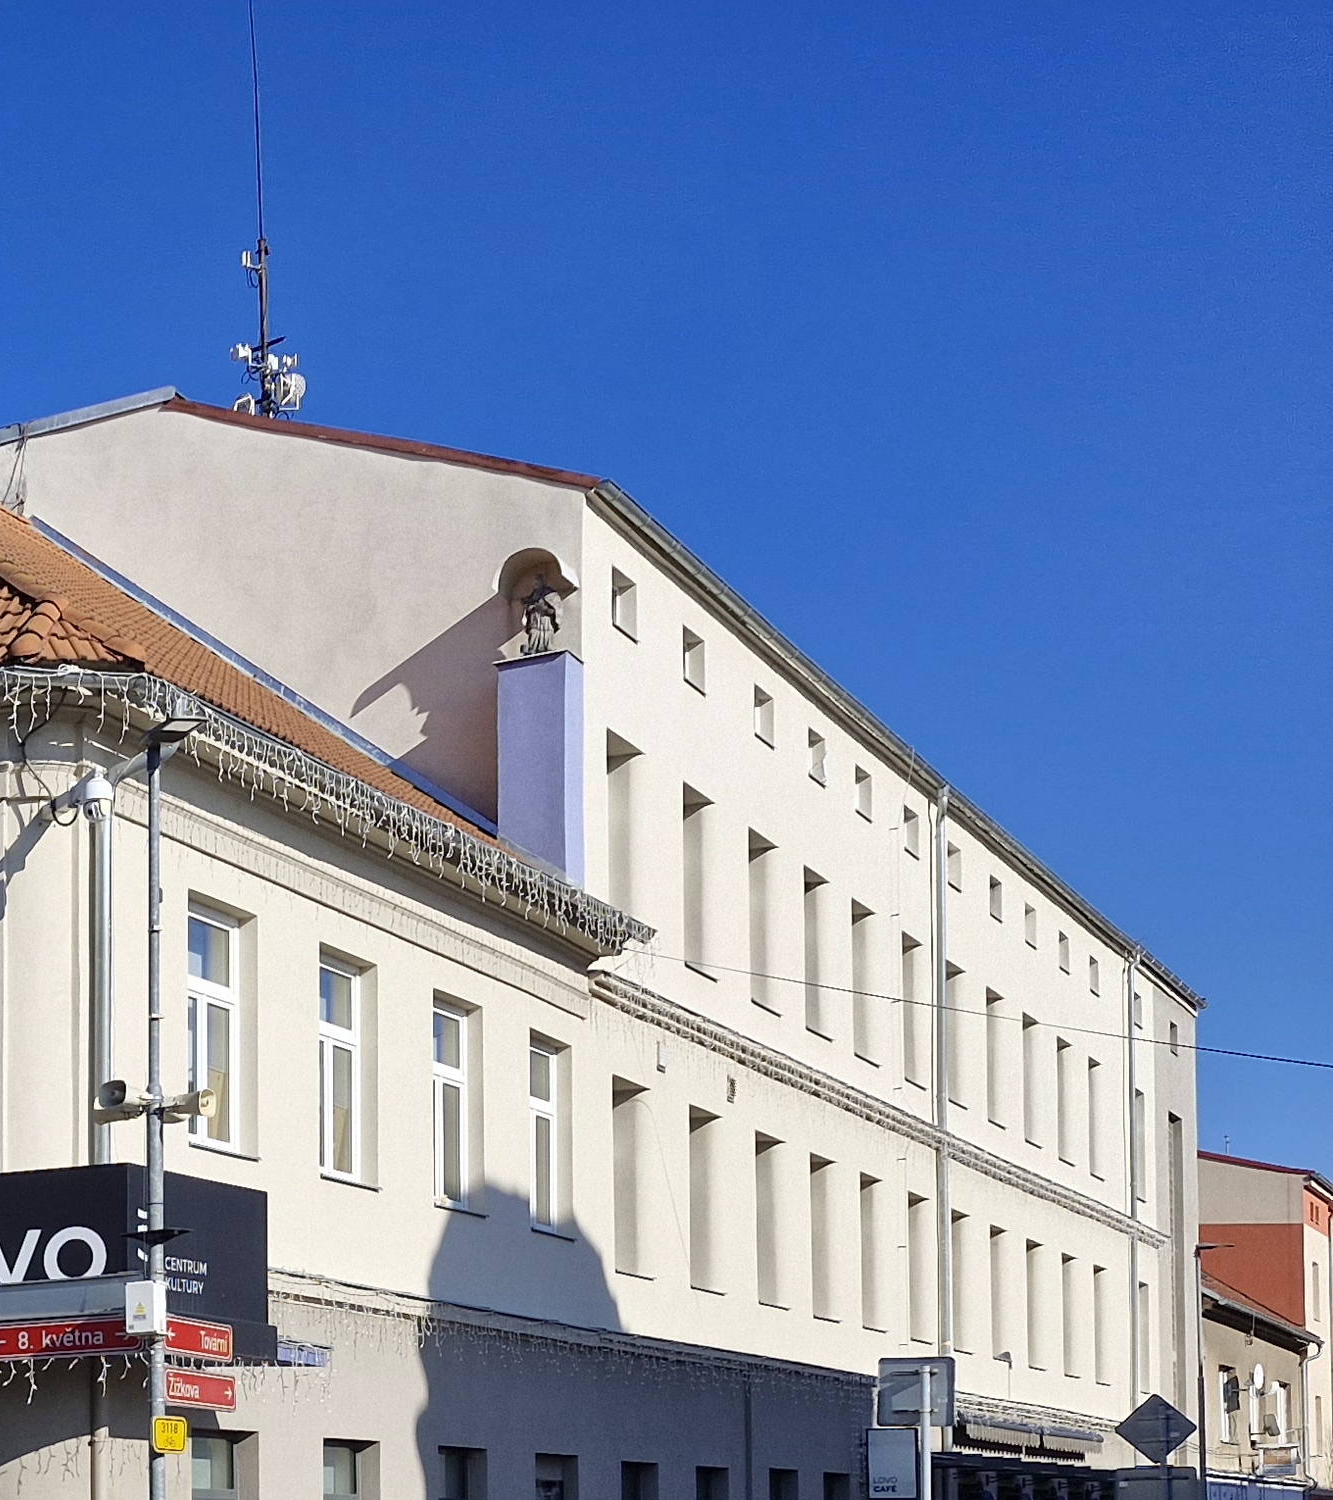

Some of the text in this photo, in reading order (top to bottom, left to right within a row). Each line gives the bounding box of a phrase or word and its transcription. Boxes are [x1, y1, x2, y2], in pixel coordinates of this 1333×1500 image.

[164, 1256, 208, 1276] CENTRUM
[165, 1276, 205, 1295] KULTURY
[17, 1327, 104, 1350] 8. května
[199, 1330, 228, 1353] Tovární
[167, 1372, 200, 1399] Žižkova
[160, 1421, 179, 1434] 3118
